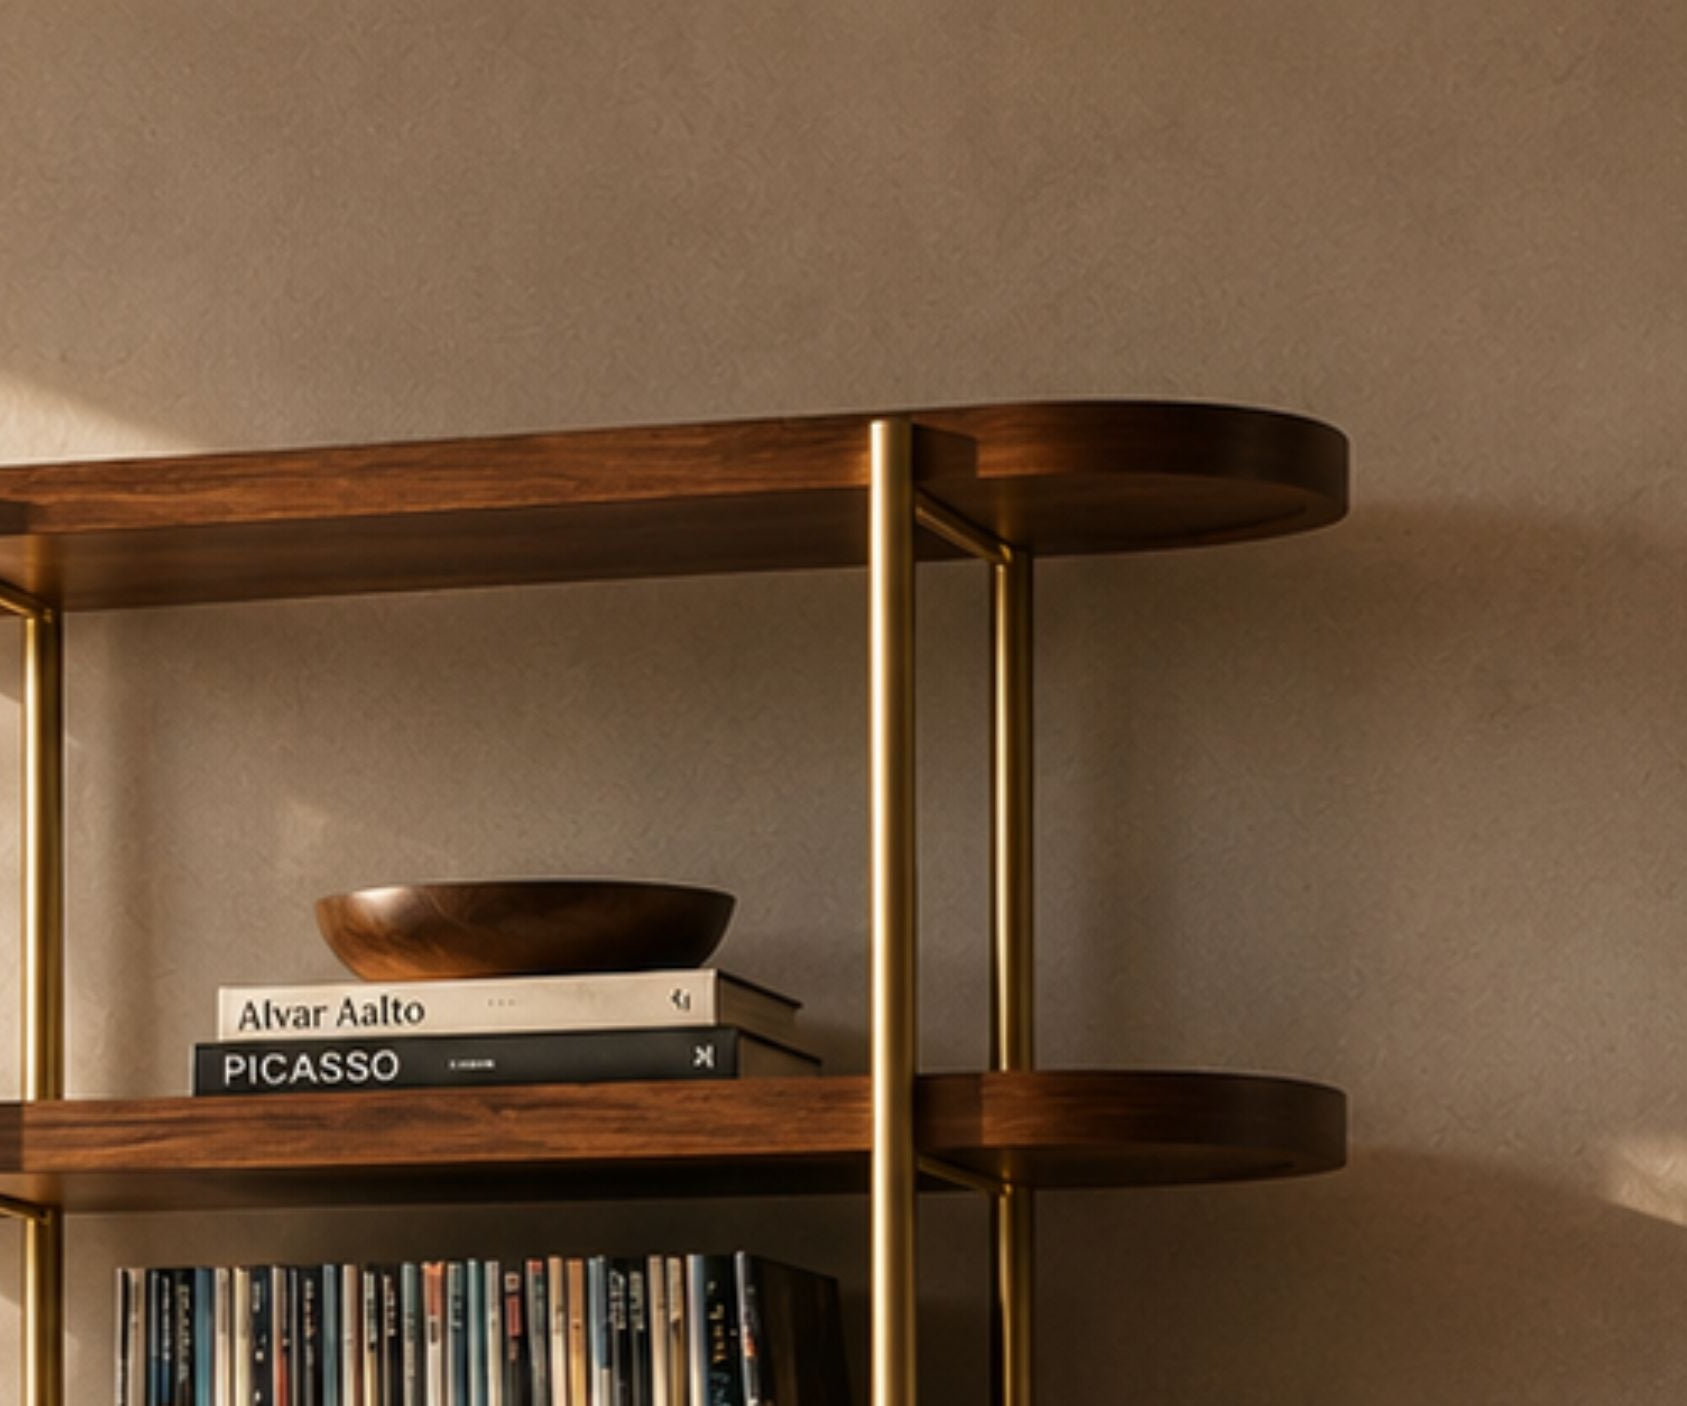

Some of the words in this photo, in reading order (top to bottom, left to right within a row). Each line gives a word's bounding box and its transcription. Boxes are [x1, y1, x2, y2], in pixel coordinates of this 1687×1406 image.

[238, 999, 327, 1031] Alvar
[336, 994, 425, 1027] Aalto
[224, 1049, 400, 1085] PICASSO
